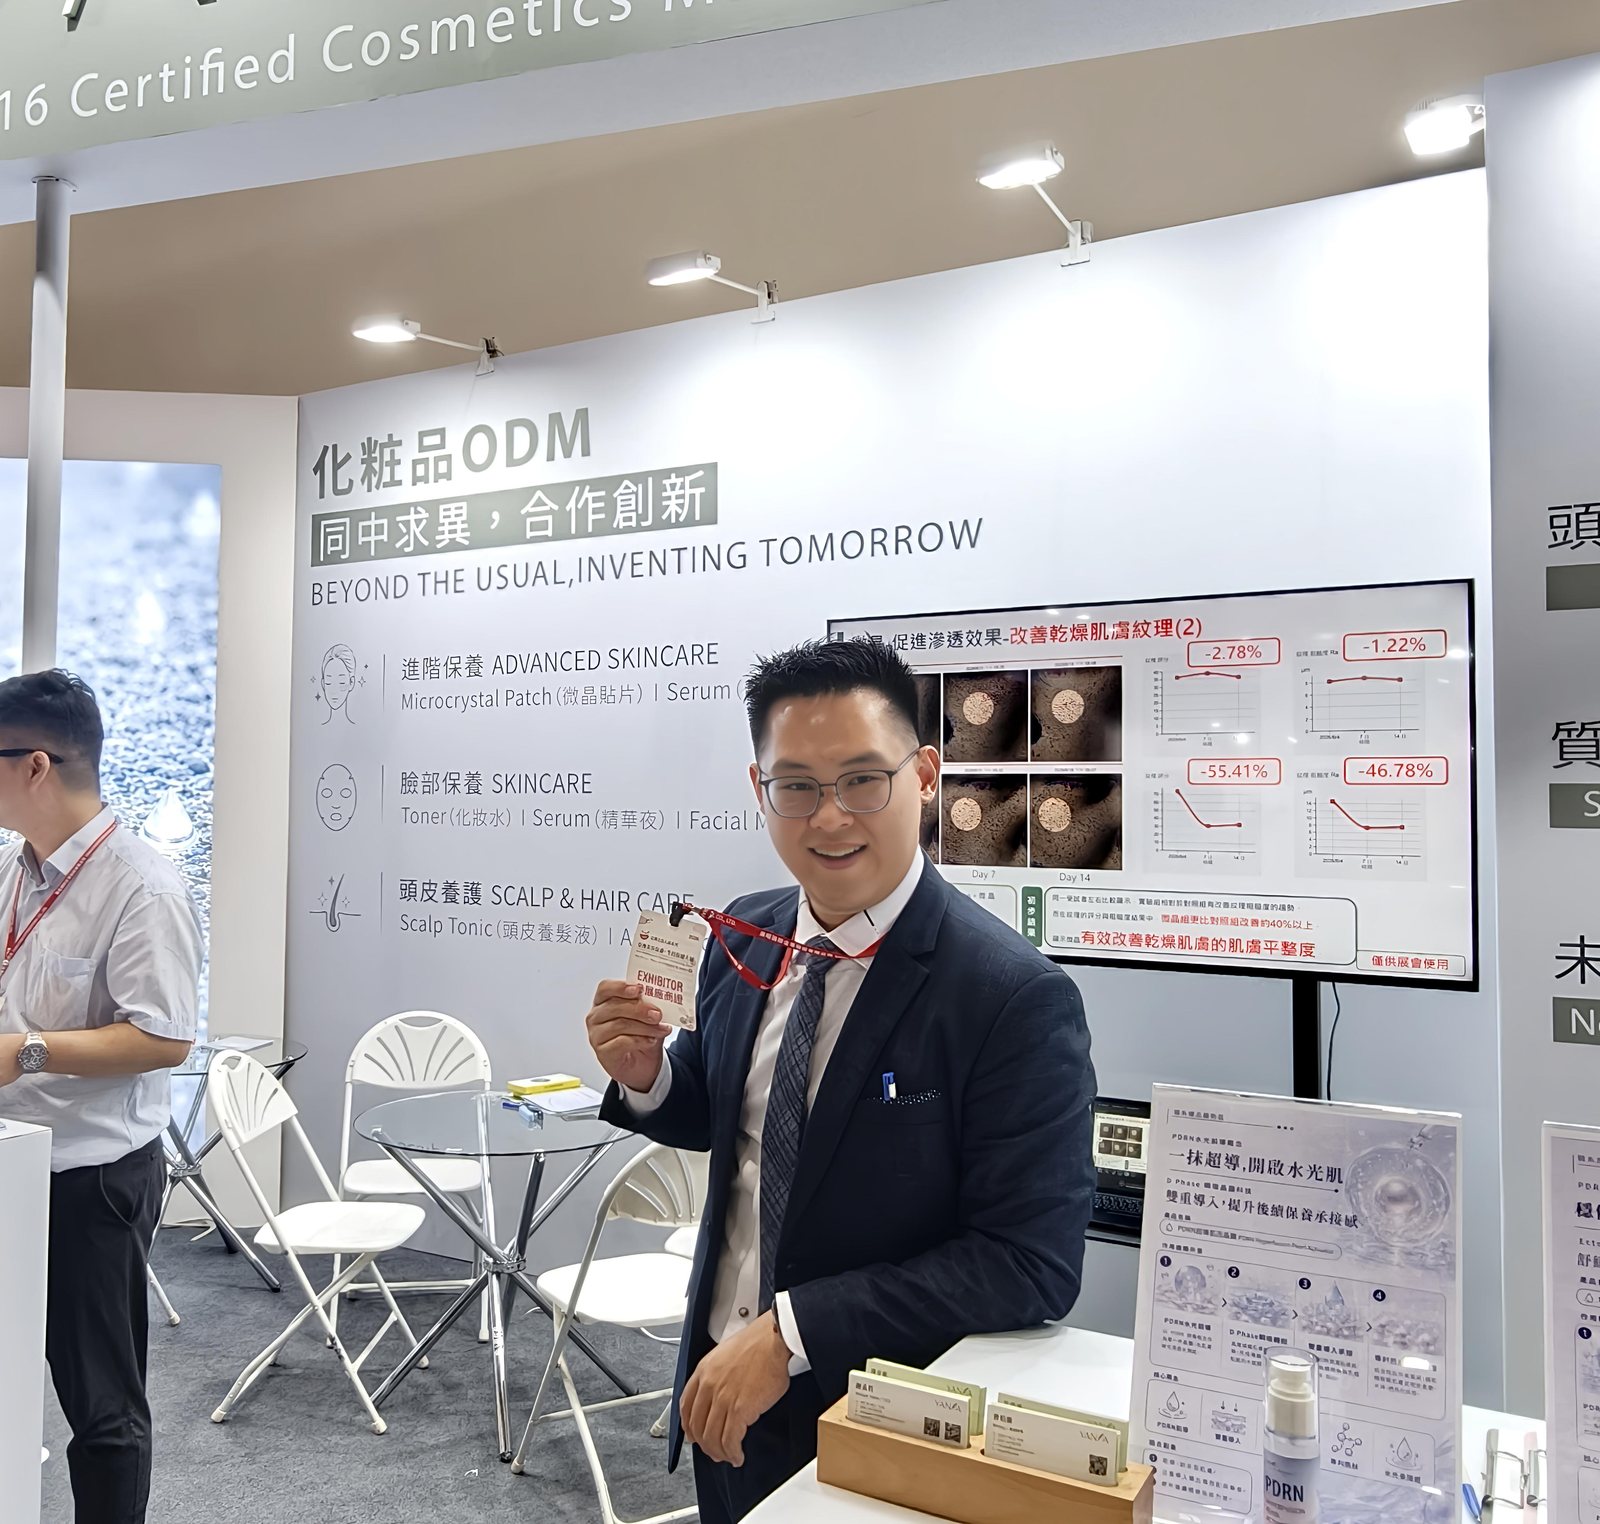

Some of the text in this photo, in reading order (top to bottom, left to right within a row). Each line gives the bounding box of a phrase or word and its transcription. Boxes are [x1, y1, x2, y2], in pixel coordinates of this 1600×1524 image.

[71, 33, 296, 118] Certified
[322, 0, 632, 73] Cosmetics
[312, 407, 591, 499] 化粧品ODM
[319, 469, 706, 562] 同中求異，合作創新
[1547, 502, 1600, 550] 頭
[311, 574, 408, 606] BEYOND
[417, 568, 465, 598] THE
[759, 517, 983, 568] TOMORROW
[1205, 644, 1263, 661] -2.78%
[1362, 636, 1427, 654] -1.22%
[401, 642, 719, 682] 進階保養 ADVANCED SKINCARE
[401, 688, 499, 714] Microcrystal
[1551, 721, 1600, 769] 質
[400, 771, 592, 796] 臉部保養 SKINCARE
[1200, 763, 1269, 779] -55.41%
[1358, 762, 1434, 779] -46.78%
[690, 810, 748, 831] Facial
[755, 811, 767, 831] M
[972, 870, 996, 881] Day 7
[1059, 872, 1091, 884] Day 14
[399, 879, 483, 906] 頭皮養護
[490, 884, 555, 908] SCALP
[559, 887, 575, 909] &
[580, 889, 631, 913] HAIR
[400, 913, 443, 938] Scalp
[1555, 935, 1600, 985] 未
[637, 969, 684, 993] EXHIBITOR
[1571, 1007, 1600, 1036] N
[1265, 1474, 1304, 1503] PDRN
